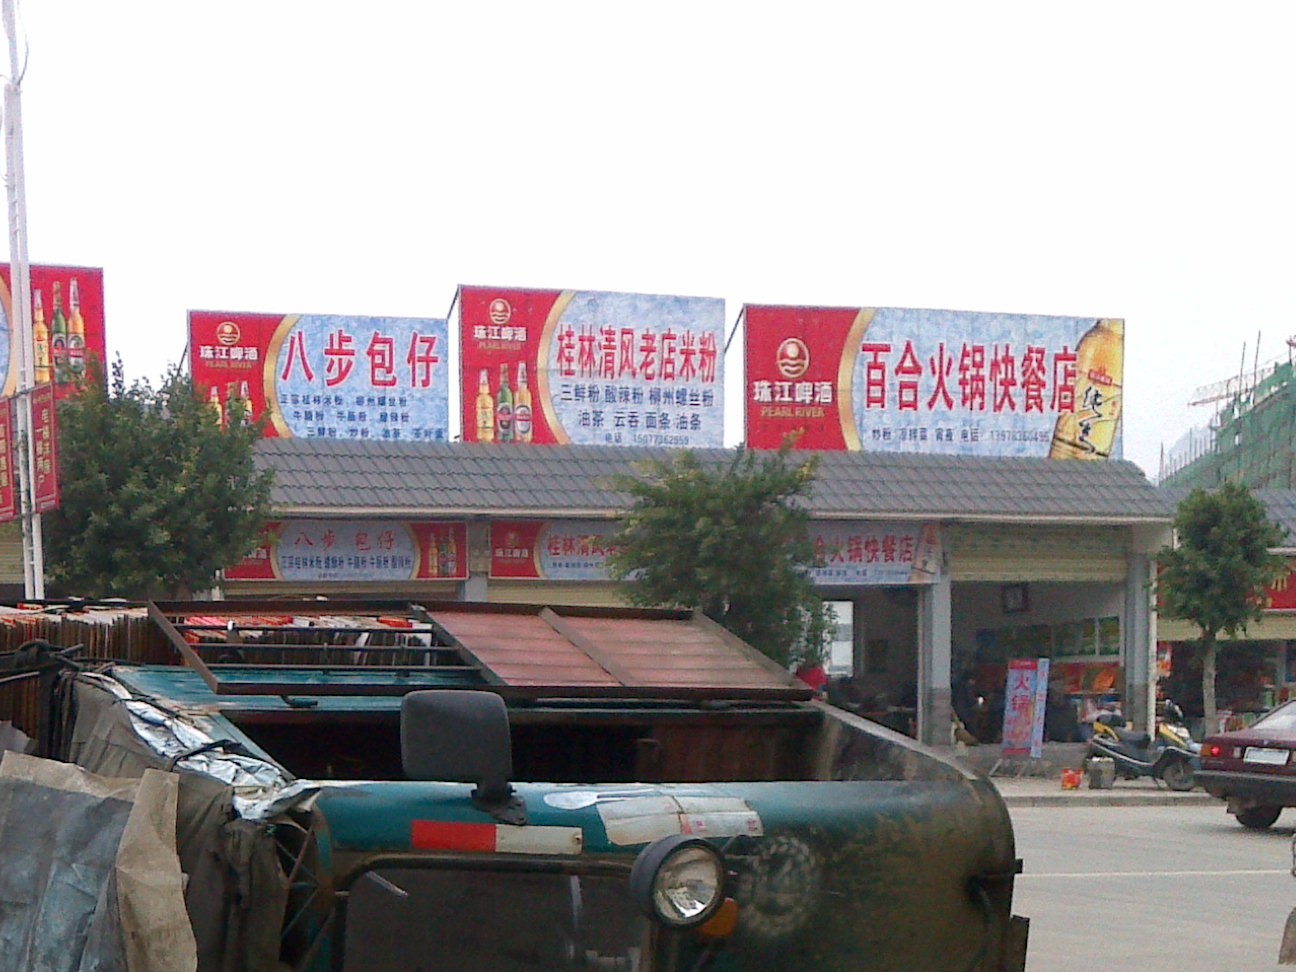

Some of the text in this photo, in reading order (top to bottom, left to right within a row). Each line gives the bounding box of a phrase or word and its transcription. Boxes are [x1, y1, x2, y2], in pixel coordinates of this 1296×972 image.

[281, 329, 439, 388] 八步包仔
[557, 324, 717, 383] 桂林清风老店米粉
[861, 340, 1078, 413] 百合火锅快餐店
[753, 380, 832, 404] 珠江啤酒
[762, 406, 825, 418] PEARL RIVER
